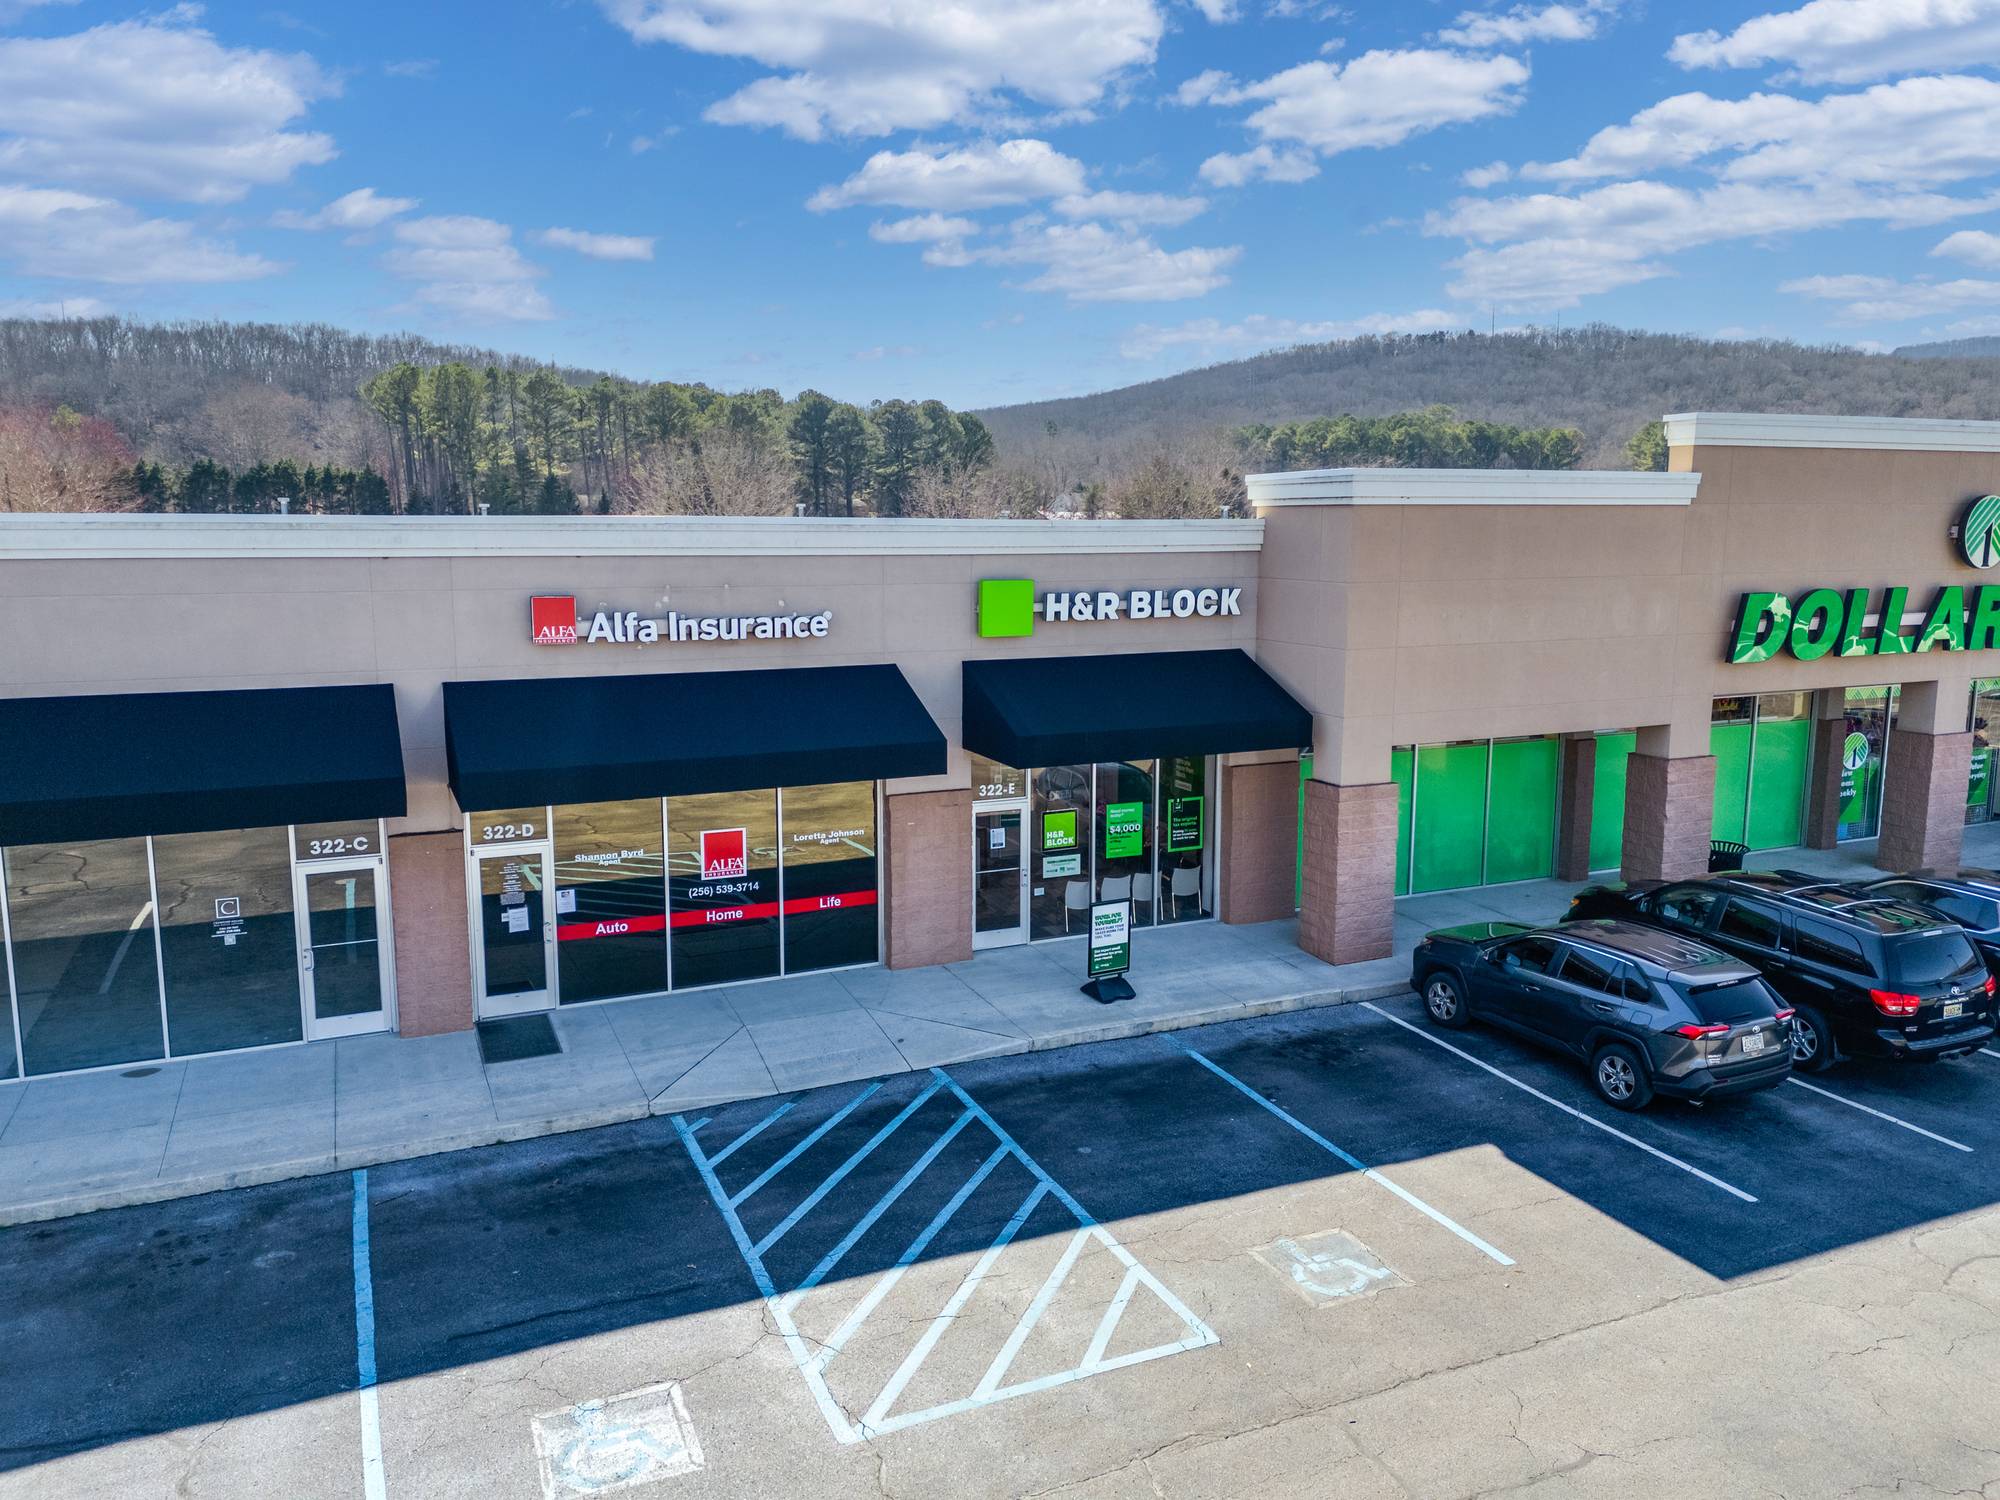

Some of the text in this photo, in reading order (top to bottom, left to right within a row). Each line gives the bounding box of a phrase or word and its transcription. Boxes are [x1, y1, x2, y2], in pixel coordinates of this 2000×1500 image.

[1045, 588, 1242, 621] H&R BLOCK
[587, 612, 658, 643] Alfa
[1725, 584, 2000, 664] DOLLAR
[540, 625, 575, 638] ALFA
[979, 783, 1015, 796] 322-E
[483, 823, 534, 840] 322-D
[794, 828, 865, 842] Loretta Johnson
[1046, 830, 1065, 839] H&R
[1109, 823, 1141, 835] $4,000
[310, 836, 369, 855] 322-C
[819, 836, 840, 845] Agent
[1046, 837, 1074, 847] BLOCK
[574, 848, 644, 863] Shannon Byrd
[709, 858, 743, 871] ALFA
[688, 881, 760, 899] (256) 539-3714
[819, 896, 842, 908] Life
[706, 909, 743, 922] Home
[595, 920, 629, 936] Auto
